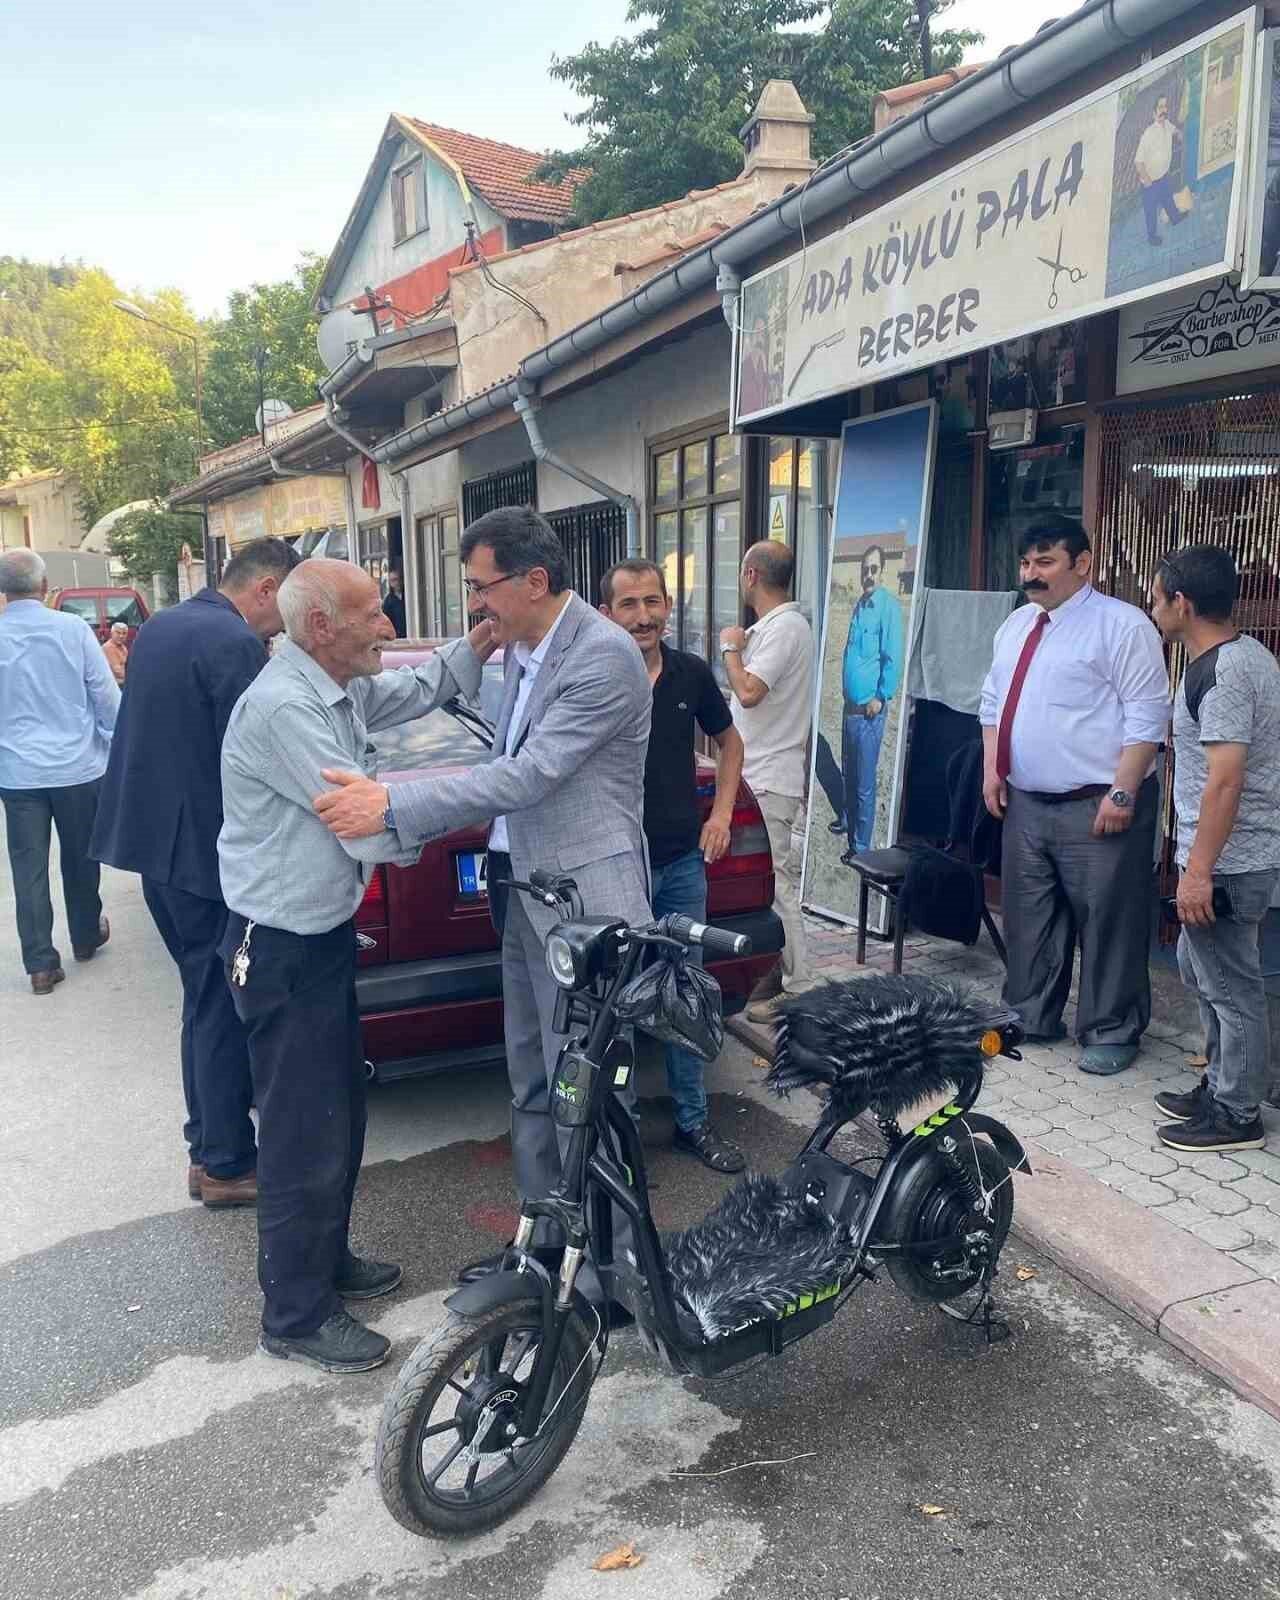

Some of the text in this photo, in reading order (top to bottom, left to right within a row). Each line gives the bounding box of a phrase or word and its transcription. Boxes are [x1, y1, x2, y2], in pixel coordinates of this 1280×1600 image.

[801, 141, 1084, 322] ADA KÖYLÜ PALA
[858, 287, 980, 368] BERBER
[1186, 303, 1263, 333] Barbershop
[1258, 333, 1278, 344] MEN
[463, 876, 475, 888] TR
